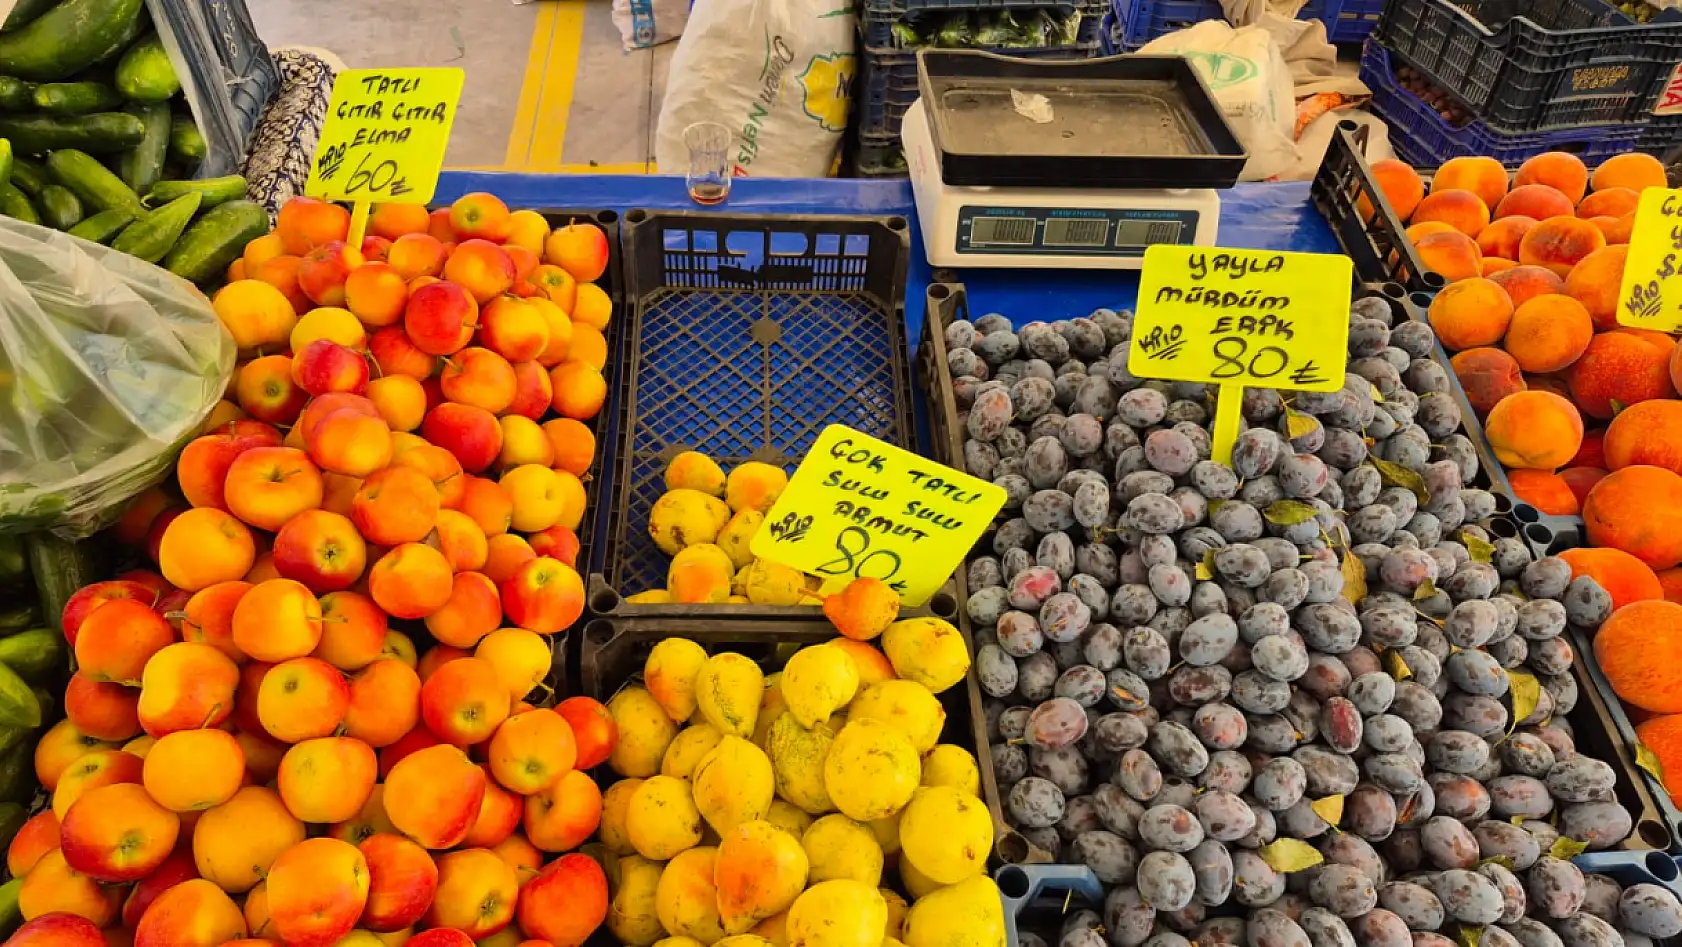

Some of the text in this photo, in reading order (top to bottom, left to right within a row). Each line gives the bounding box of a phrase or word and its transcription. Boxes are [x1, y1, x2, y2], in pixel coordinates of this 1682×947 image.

[361, 74, 421, 95] TATLI
[336, 100, 447, 124] ÇITIR ÇITIR
[350, 127, 412, 148] ELMA
[738, 102, 769, 166] Nefis
[1188, 253, 1285, 280] YAYLA
[1155, 286, 1290, 310] MÜRDÜM
[822, 470, 964, 530] SULU SULU
[907, 470, 982, 504] TATLI
[833, 500, 929, 542] ARMUT
